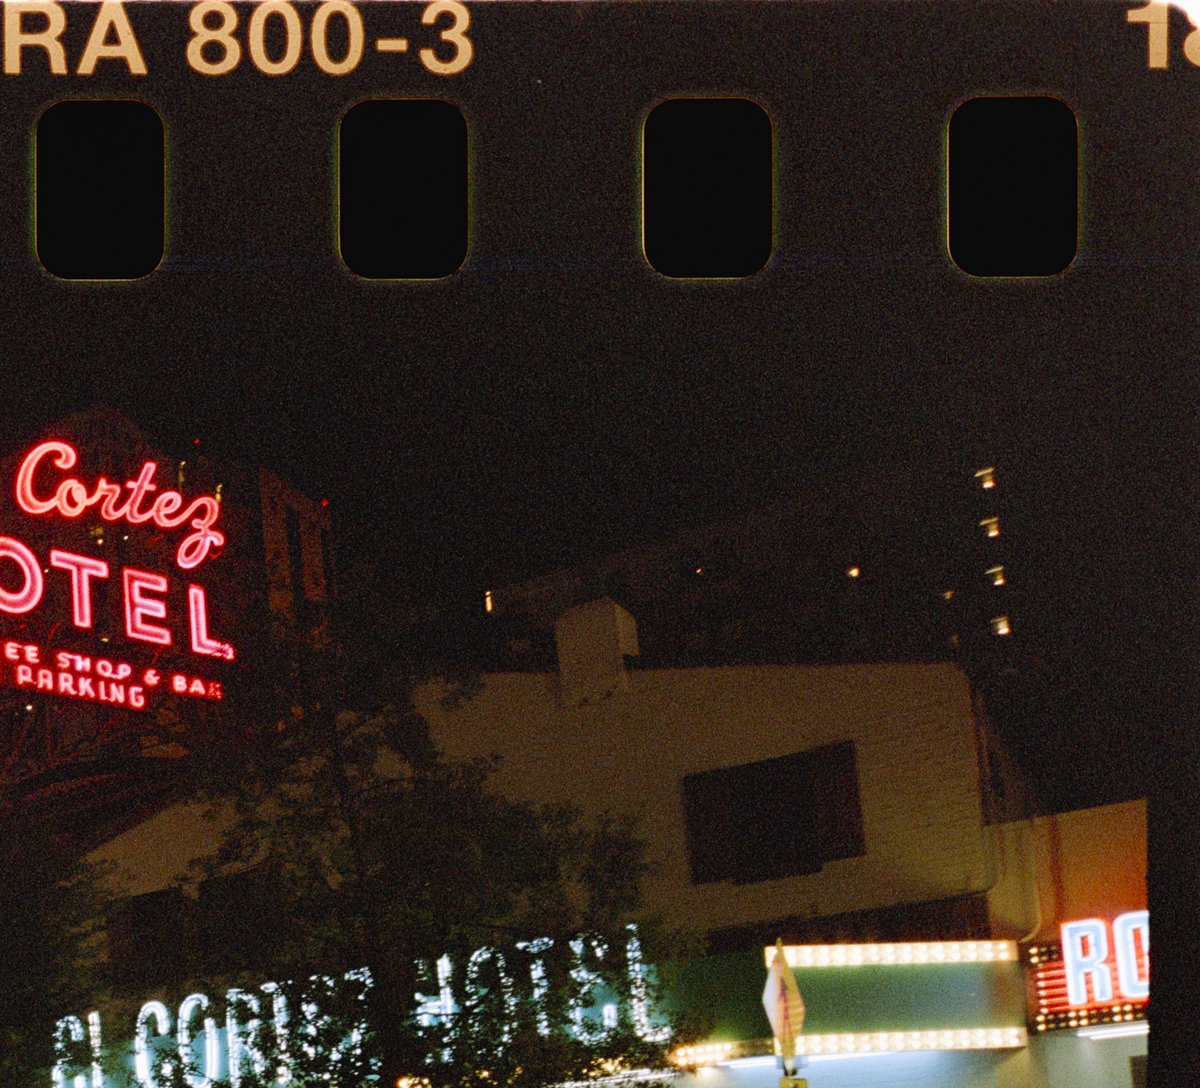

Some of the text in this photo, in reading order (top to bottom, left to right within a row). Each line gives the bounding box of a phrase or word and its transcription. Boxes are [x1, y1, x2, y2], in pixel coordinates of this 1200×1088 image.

[186, 0, 474, 75] 800-3
[1127, 2, 1200, 69] 1
[16, 441, 225, 569] Cortez
[17, 665, 145, 708] PARKING
[57, 652, 131, 679] SHOP
[144, 670, 160, 685] &
